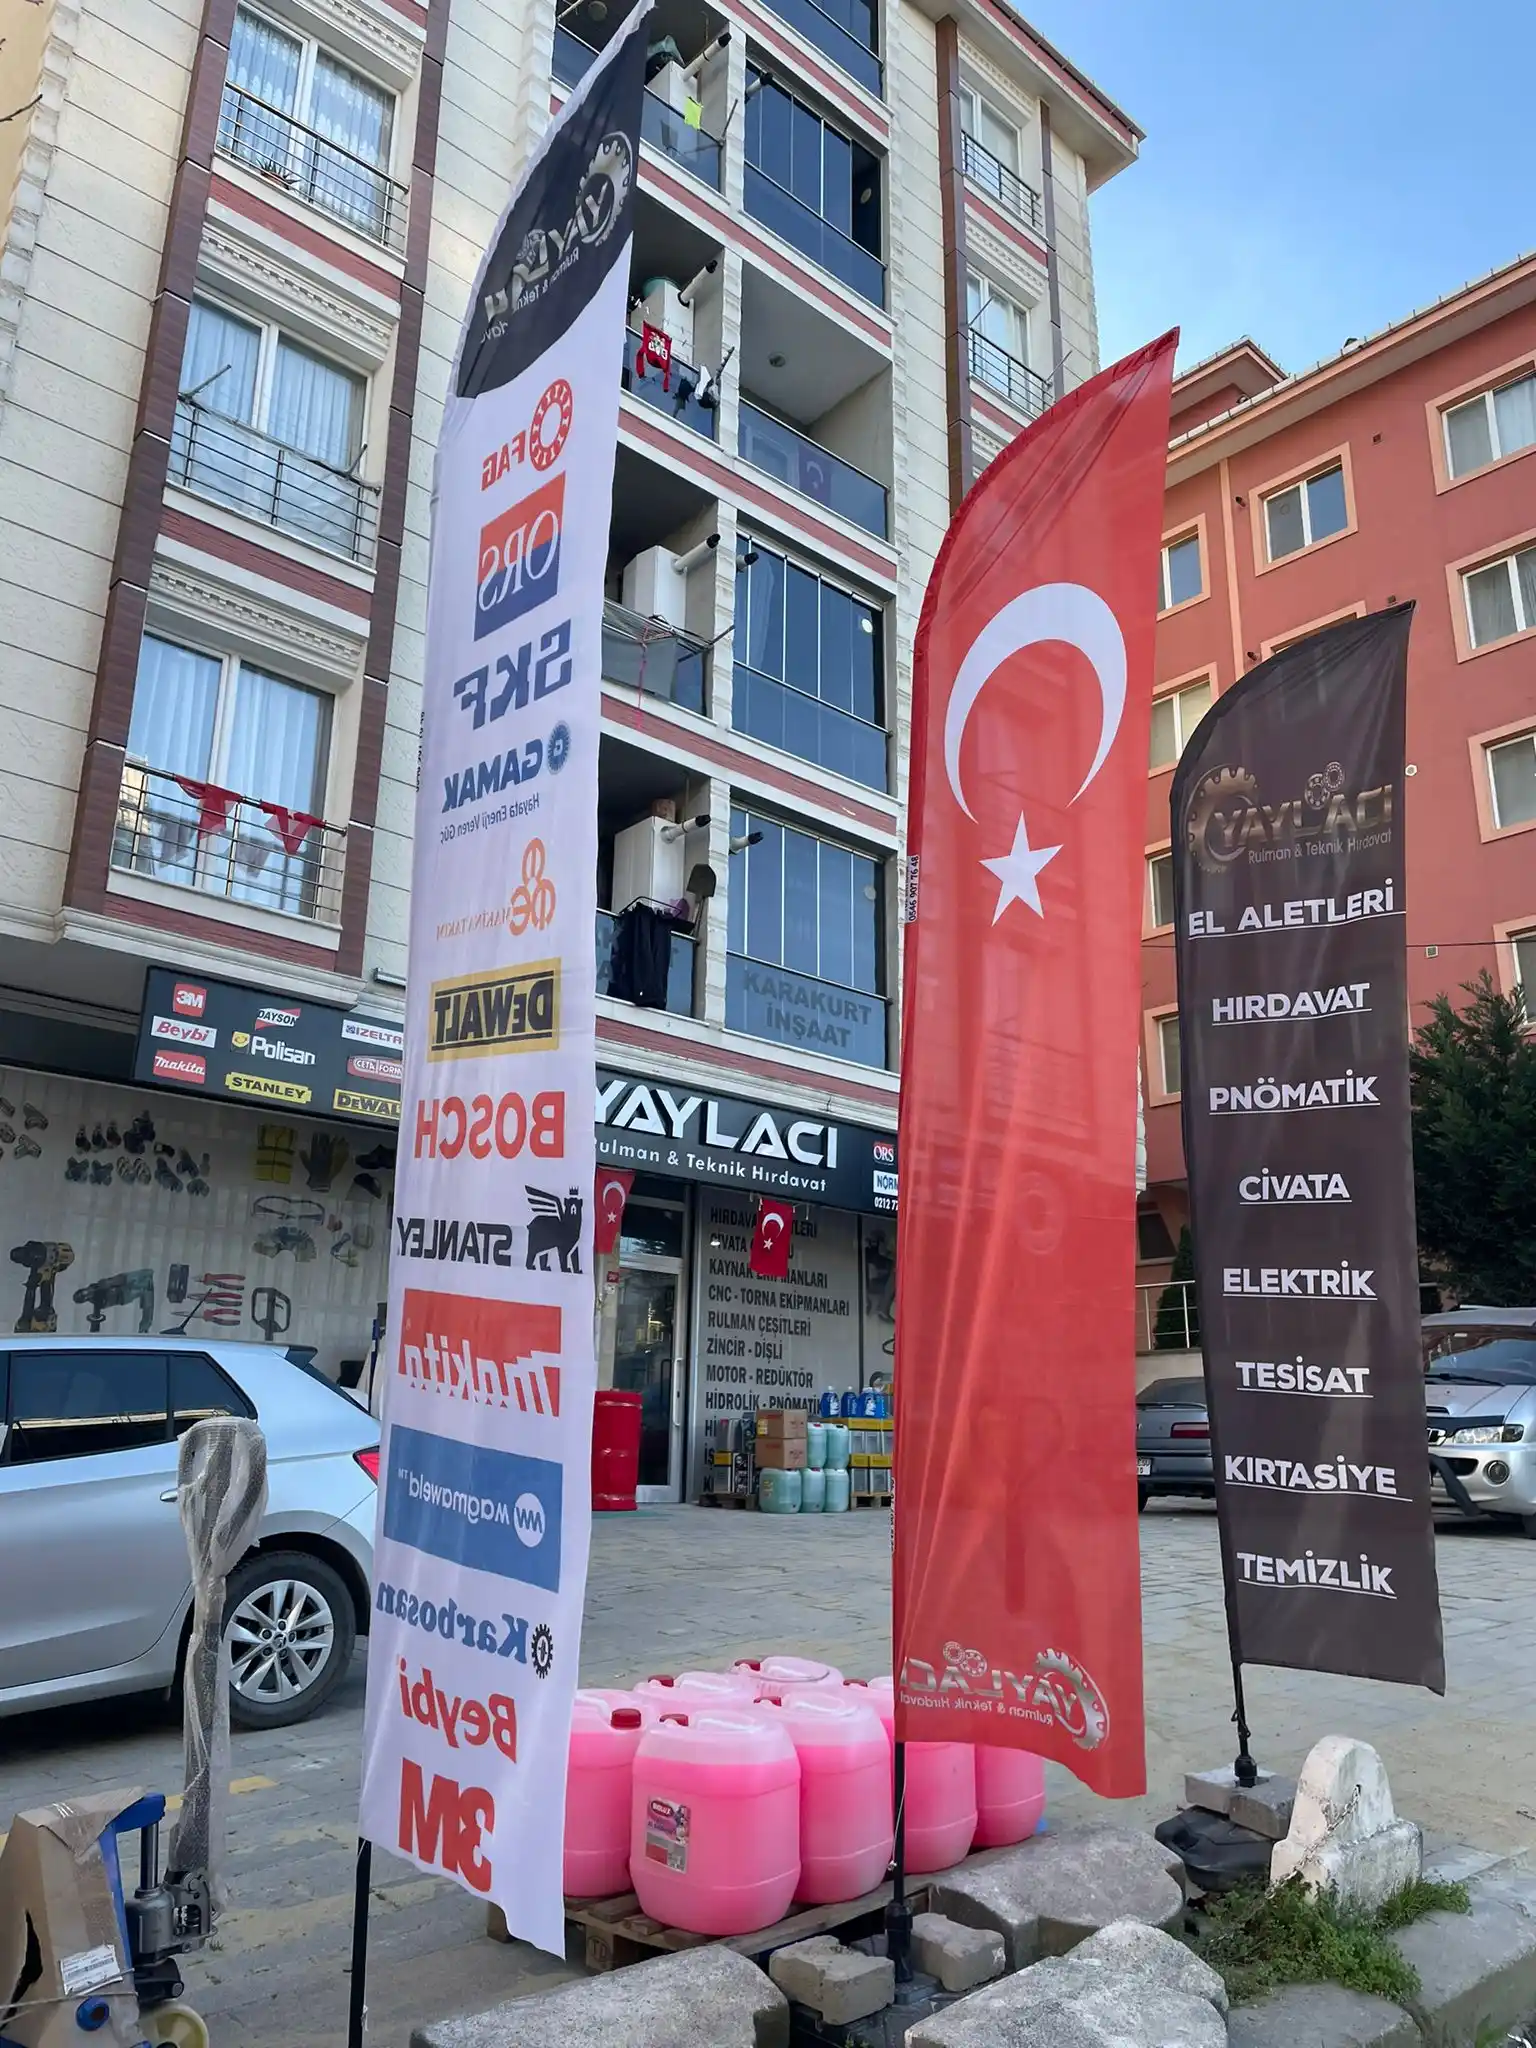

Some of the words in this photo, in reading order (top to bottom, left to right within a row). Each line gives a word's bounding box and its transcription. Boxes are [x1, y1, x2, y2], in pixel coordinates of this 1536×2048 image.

[1213, 784, 1392, 848] YAYLACI
[1248, 847, 1292, 864] Rulman
[1295, 843, 1303, 857] &
[1305, 838, 1343, 857] Teknik
[1188, 910, 1225, 936] EL
[1238, 877, 1394, 931] ALETLERİ
[176, 990, 204, 1009] 3M
[744, 969, 872, 1026] KARAKURT
[1212, 982, 1370, 1022] HIRDAVAT
[157, 1021, 210, 1042] Beybi
[355, 1027, 402, 1045] IZELTA
[766, 1003, 851, 1048] İNŞAAT
[155, 1055, 205, 1075] makita
[251, 1035, 316, 1065] Polisan
[231, 1076, 306, 1099] STANLEY
[1209, 1069, 1380, 1111] PNÖMATİK
[338, 1094, 401, 1116] DEWAL
[595, 1079, 838, 1169] YAYLACI
[595, 1137, 660, 1162] ulman
[667, 1150, 680, 1166] &
[686, 1153, 746, 1178] Teknik
[752, 1168, 827, 1192] Hırdavat
[874, 1146, 894, 1162] ORS
[1238, 1167, 1350, 1201] CİVATA
[710, 1206, 757, 1229] HIRDAVA
[874, 1196, 891, 1210] 0212
[1223, 1260, 1376, 1297] ELEKTRİK
[708, 1284, 732, 1302] CNC
[740, 1287, 777, 1306] TORNA
[779, 1290, 850, 1317] EKİPMANLARI
[707, 1311, 756, 1331] RULMAN
[758, 1314, 811, 1338] ÇEŞİTLERİ
[706, 1334, 746, 1357] ZİNCİR
[754, 1338, 783, 1364] DİŞLİ
[706, 1364, 747, 1384] MOTOR
[756, 1366, 813, 1388] REDÜKTÖR
[1235, 1356, 1370, 1394] TESİSAT
[705, 1388, 759, 1411] HİDROLİK
[1224, 1455, 1398, 1495] KIRTASİYE
[1237, 1550, 1394, 1595] TEMİZLİK
